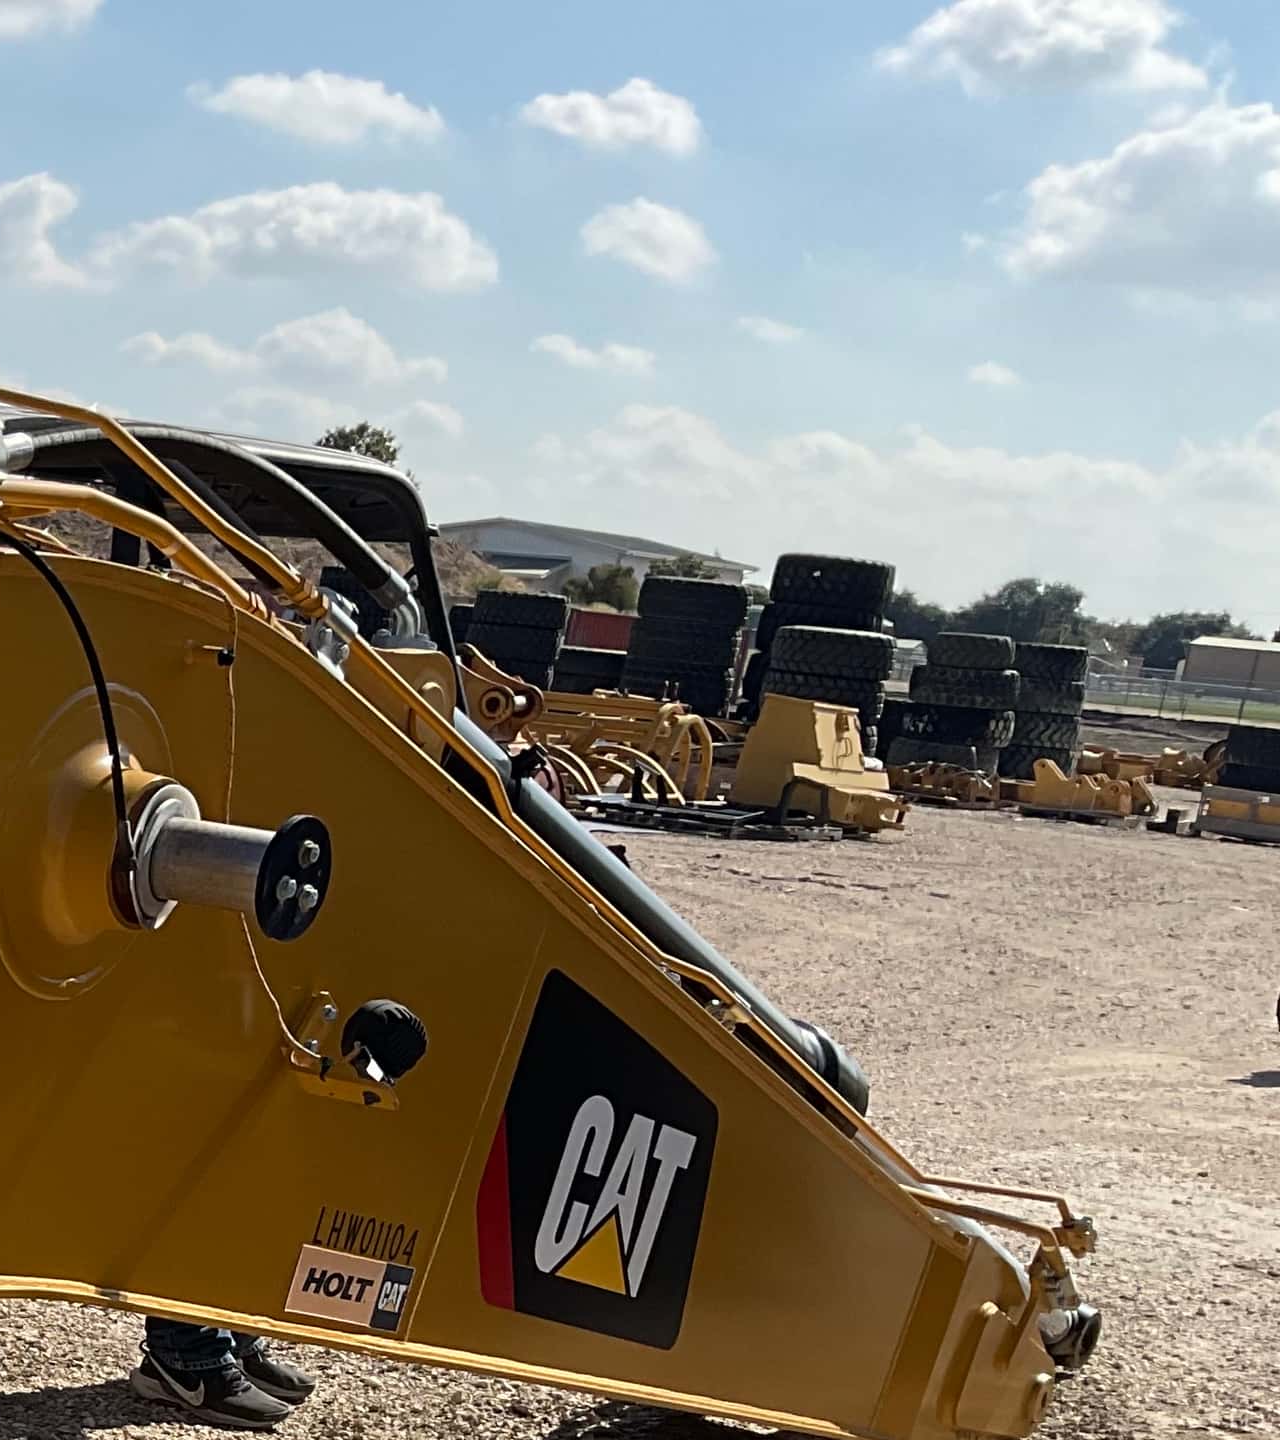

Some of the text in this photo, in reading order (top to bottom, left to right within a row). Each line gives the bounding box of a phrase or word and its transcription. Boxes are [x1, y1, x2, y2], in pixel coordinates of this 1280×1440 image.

[534, 1095, 697, 1298] CAT
[302, 1267, 408, 1313] HOLT CAT
